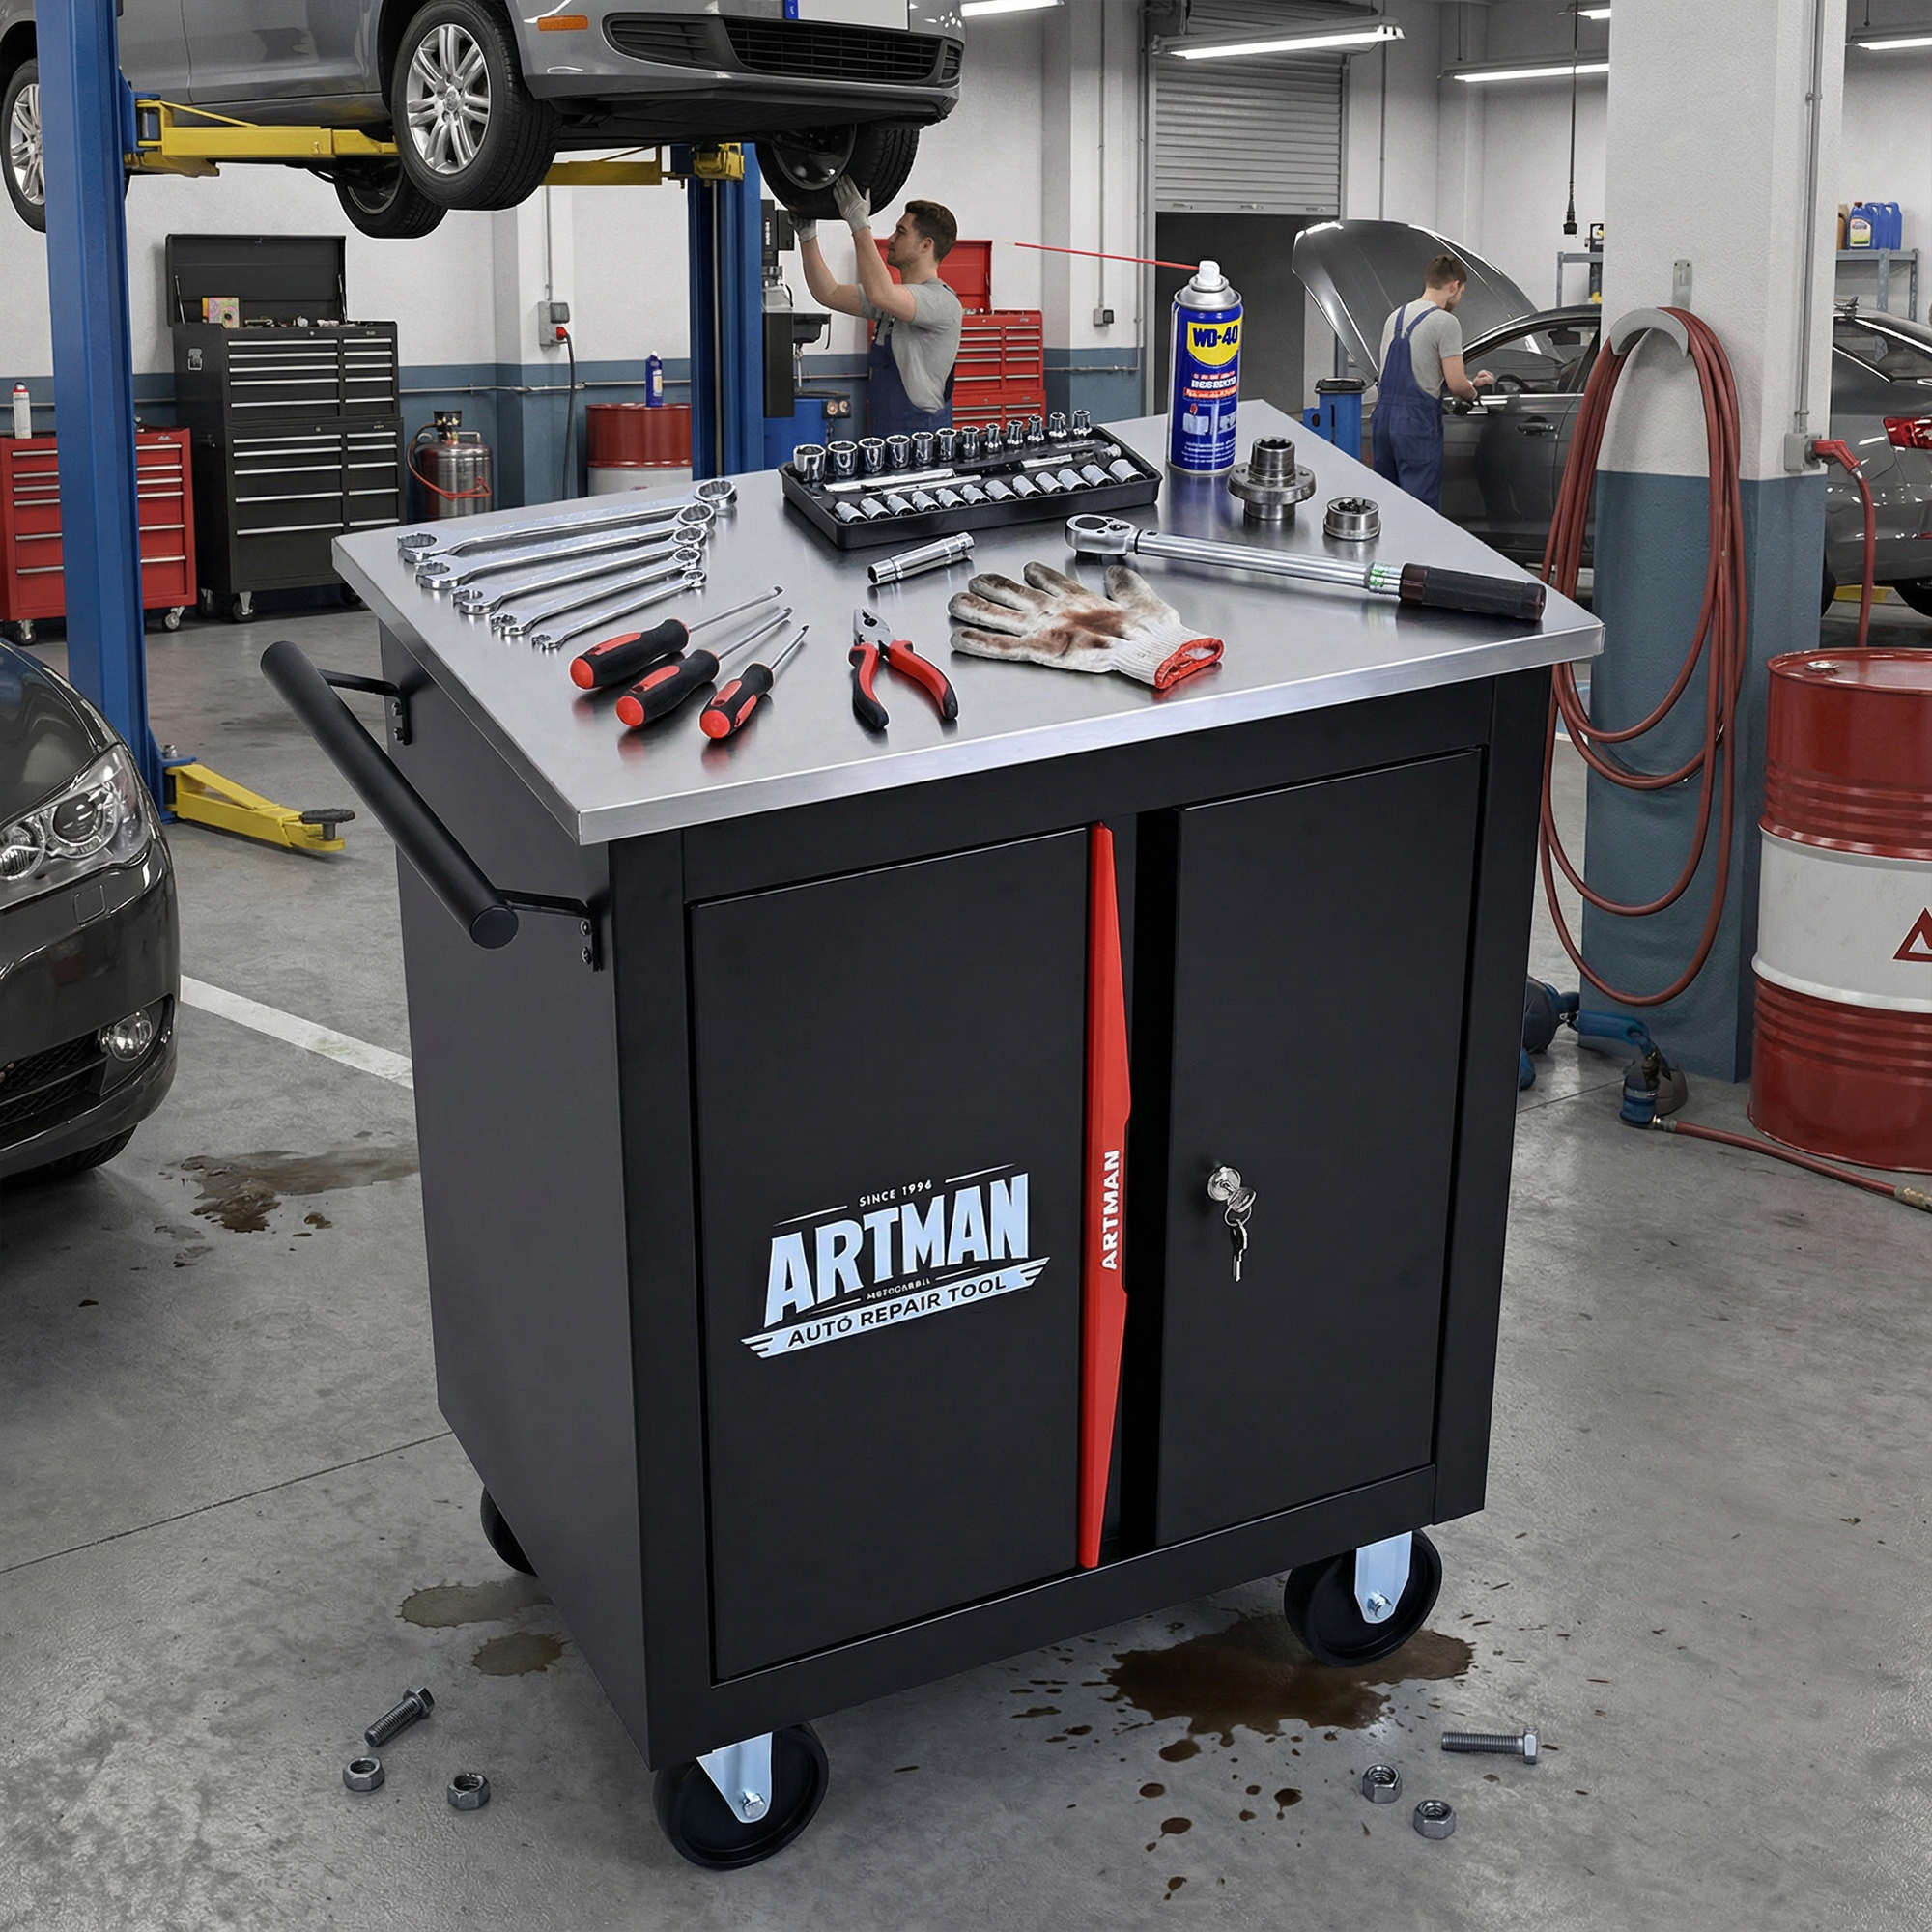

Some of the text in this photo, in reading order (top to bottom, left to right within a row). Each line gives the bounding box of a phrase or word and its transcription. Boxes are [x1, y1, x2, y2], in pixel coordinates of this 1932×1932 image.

[859, 1188, 896, 1208] SINCE
[1102, 1150, 1121, 1270] ARTMAN
[763, 1173, 1030, 1328] ARTMAN
[787, 1275, 1007, 1347] AUTO REPAIR TOOL
